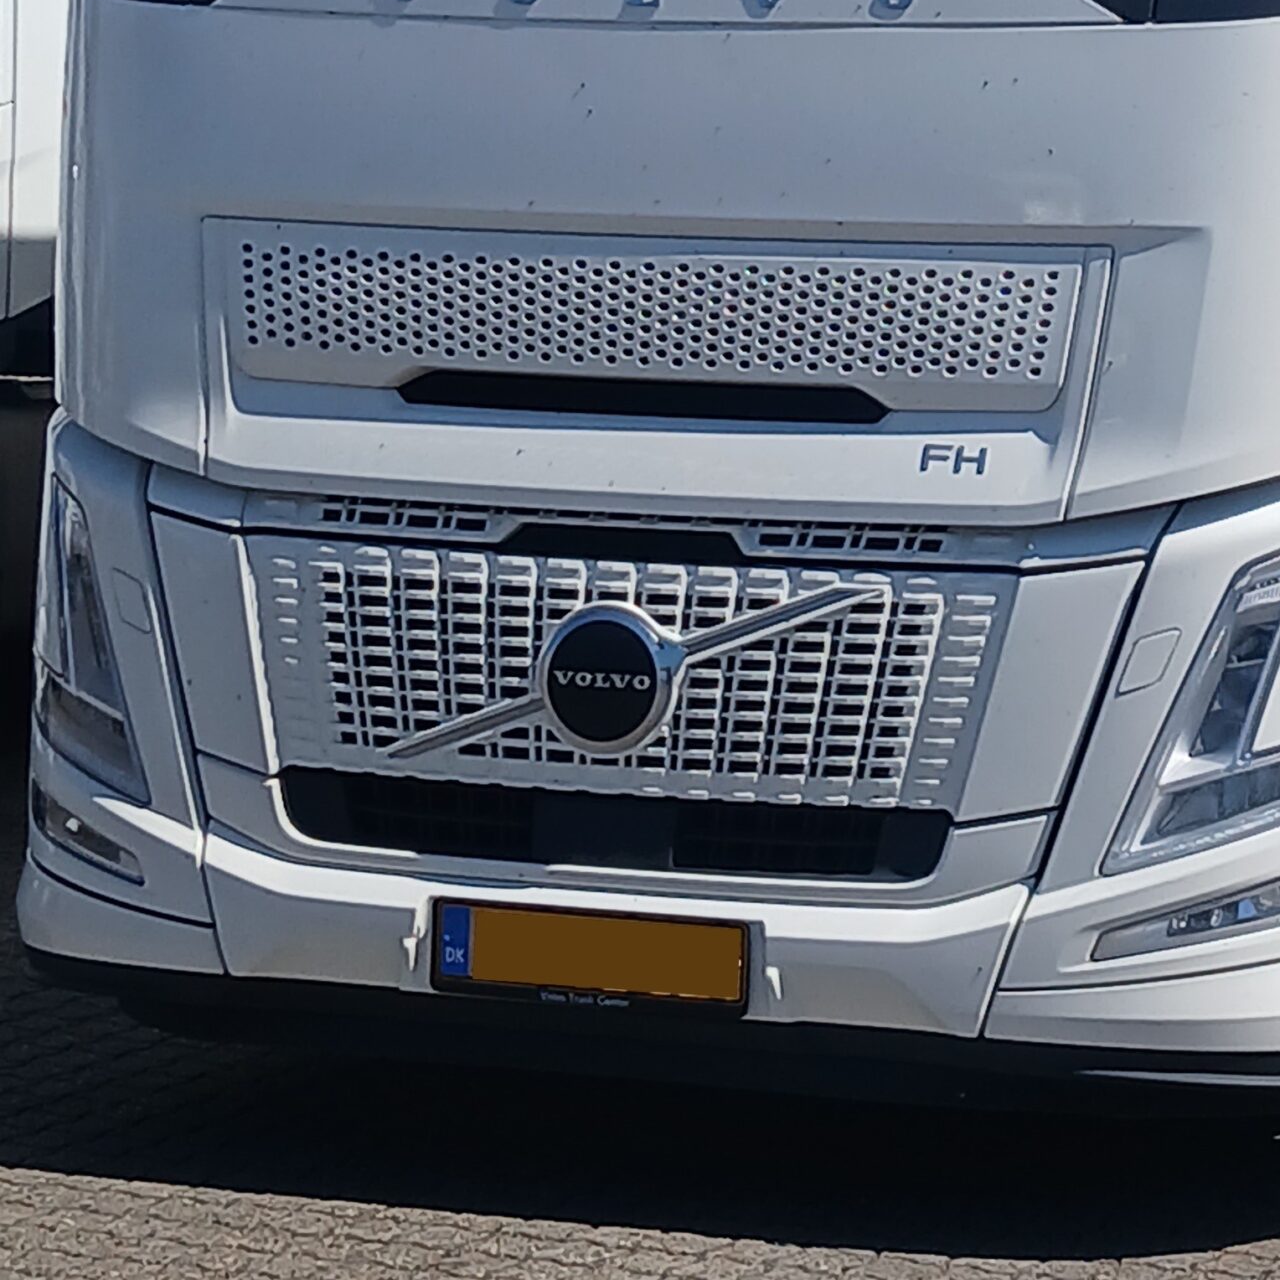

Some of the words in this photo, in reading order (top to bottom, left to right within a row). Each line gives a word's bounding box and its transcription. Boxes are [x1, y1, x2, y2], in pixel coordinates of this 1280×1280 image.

[920, 443, 987, 475] FH
[553, 669, 651, 690] VOLVO
[445, 946, 465, 963] DK
